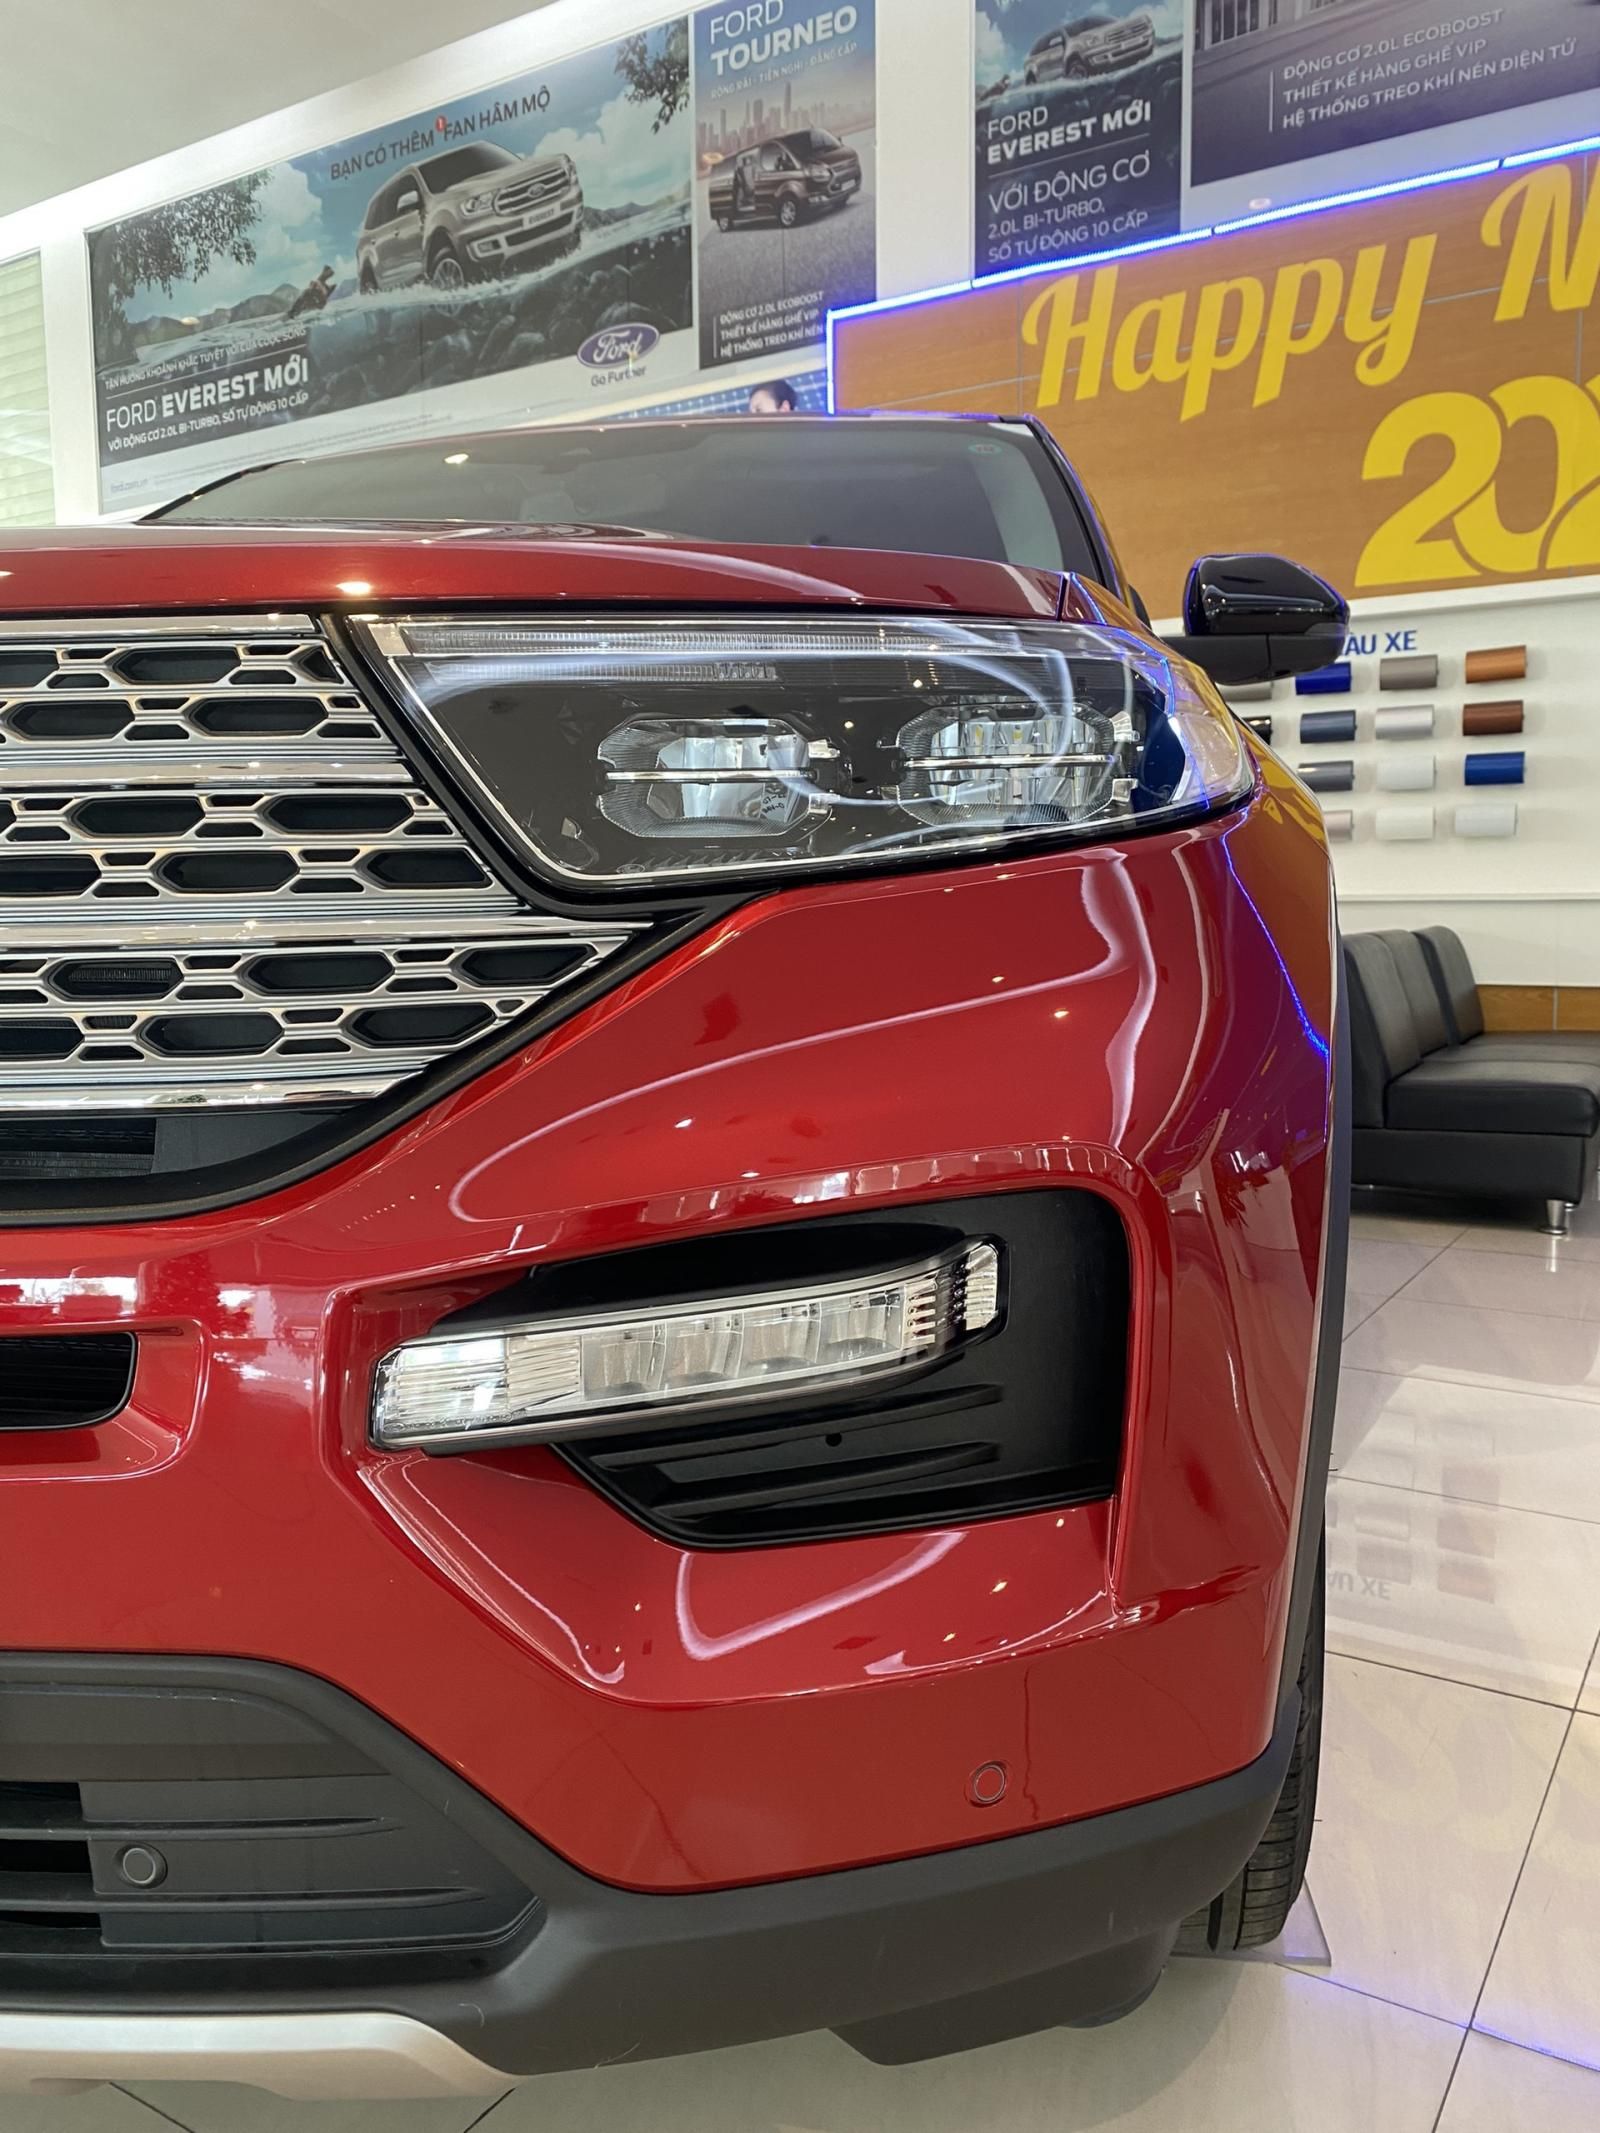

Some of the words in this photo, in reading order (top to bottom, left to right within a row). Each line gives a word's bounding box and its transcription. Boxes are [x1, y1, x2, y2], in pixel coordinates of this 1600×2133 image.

[710, 0, 783, 45] FORD
[710, 5, 857, 76] TOURNEO
[1284, 55, 1332, 80] ĐỘNG
[1336, 45, 1361, 65] CƠ
[1363, 38, 1399, 59] 2.0L
[1404, 8, 1503, 47] ECOBOOST
[1282, 107, 1305, 129] HỆ
[1308, 93, 1370, 122] THỐNG
[1372, 81, 1420, 105] TREO
[1424, 67, 1455, 92] KHÍ
[1458, 60, 1497, 83] NÉN
[1501, 48, 1544, 72] ĐIỆN
[1283, 76, 1332, 104] THIẾT
[1335, 66, 1359, 90] KẾ
[1361, 58, 1411, 84] HÀNG
[1414, 40, 1452, 69] GHẾ
[1456, 38, 1487, 58] VIP
[330, 156, 363, 181] BẠN
[364, 142, 387, 168] CÓ
[389, 130, 434, 159] THÊM
[444, 116, 476, 142] FAN
[479, 99, 518, 130] HÂM
[522, 85, 550, 115] MỘ
[987, 105, 1049, 140] FORD
[987, 116, 1097, 164] EVEREST
[1102, 99, 1151, 133] MỚI
[988, 182, 1028, 214] VỚI
[1033, 164, 1107, 201] ĐỘNG
[1112, 149, 1150, 182] CƠ
[987, 219, 1020, 240] 2.0L
[1023, 197, 1105, 231] BI-TURBO,
[988, 238, 1012, 264] SỐ
[1014, 234, 1040, 256] TỰ
[1039, 225, 1089, 251] ĐỘNG
[1093, 221, 1110, 237] 10
[1112, 208, 1149, 233] CẤP
[777, 290, 824, 311] ECOBOOST
[803, 308, 819, 320] VIP
[1021, 233, 1438, 423] Happy
[764, 333, 787, 347] TREO
[106, 399, 156, 432] FORD
[162, 371, 259, 418] EVEREST
[264, 354, 309, 392] MỚI
[591, 374, 606, 387] Go
[160, 424, 178, 439] 2.0L
[222, 406, 236, 423] SỐ
[277, 397, 288, 410] 10
[1344, 631, 1377, 656] ÀU
[1385, 629, 1417, 653] XE
